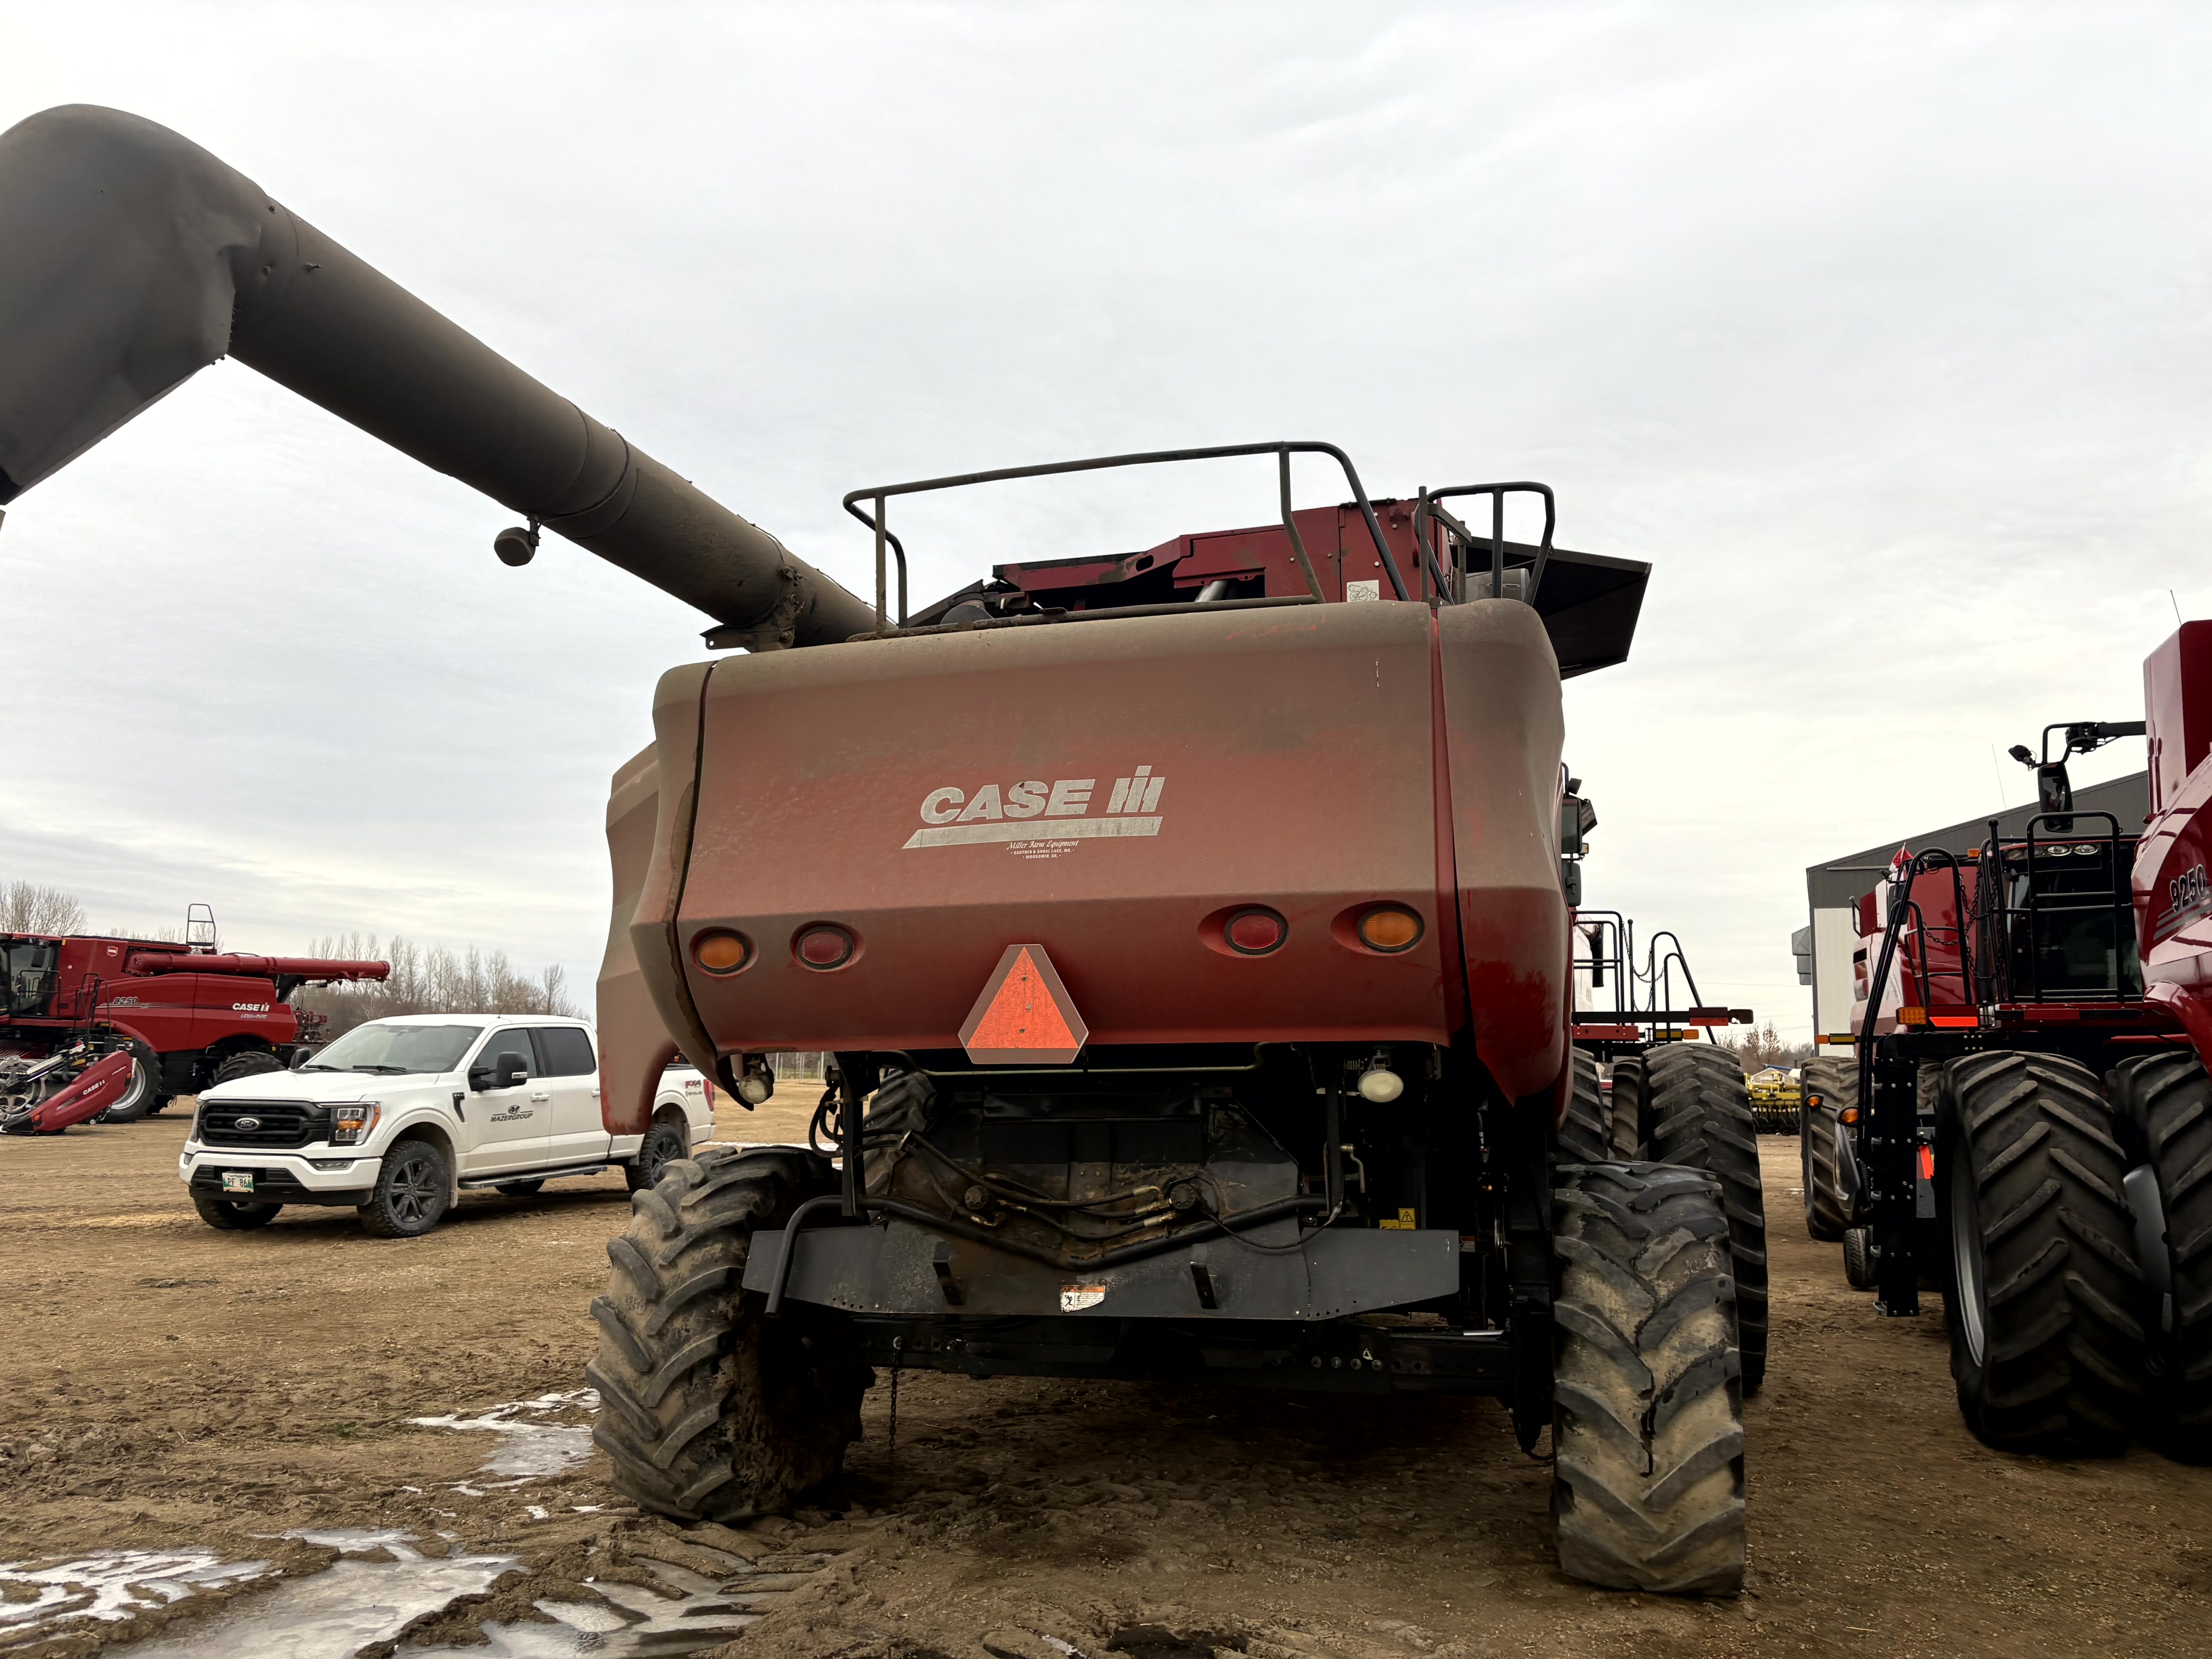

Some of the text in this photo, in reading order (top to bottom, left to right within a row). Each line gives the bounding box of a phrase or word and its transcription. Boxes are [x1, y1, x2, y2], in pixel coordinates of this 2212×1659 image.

[920, 779, 1096, 824] CASE
[1006, 842, 1027, 850] Miller
[1046, 840, 1079, 849] Equipment
[2170, 863, 2207, 913] 9250
[232, 1002, 260, 1011] CASE
[83, 1082, 99, 1095] CASE
[490, 1113, 533, 1122] MAZERGROUP
